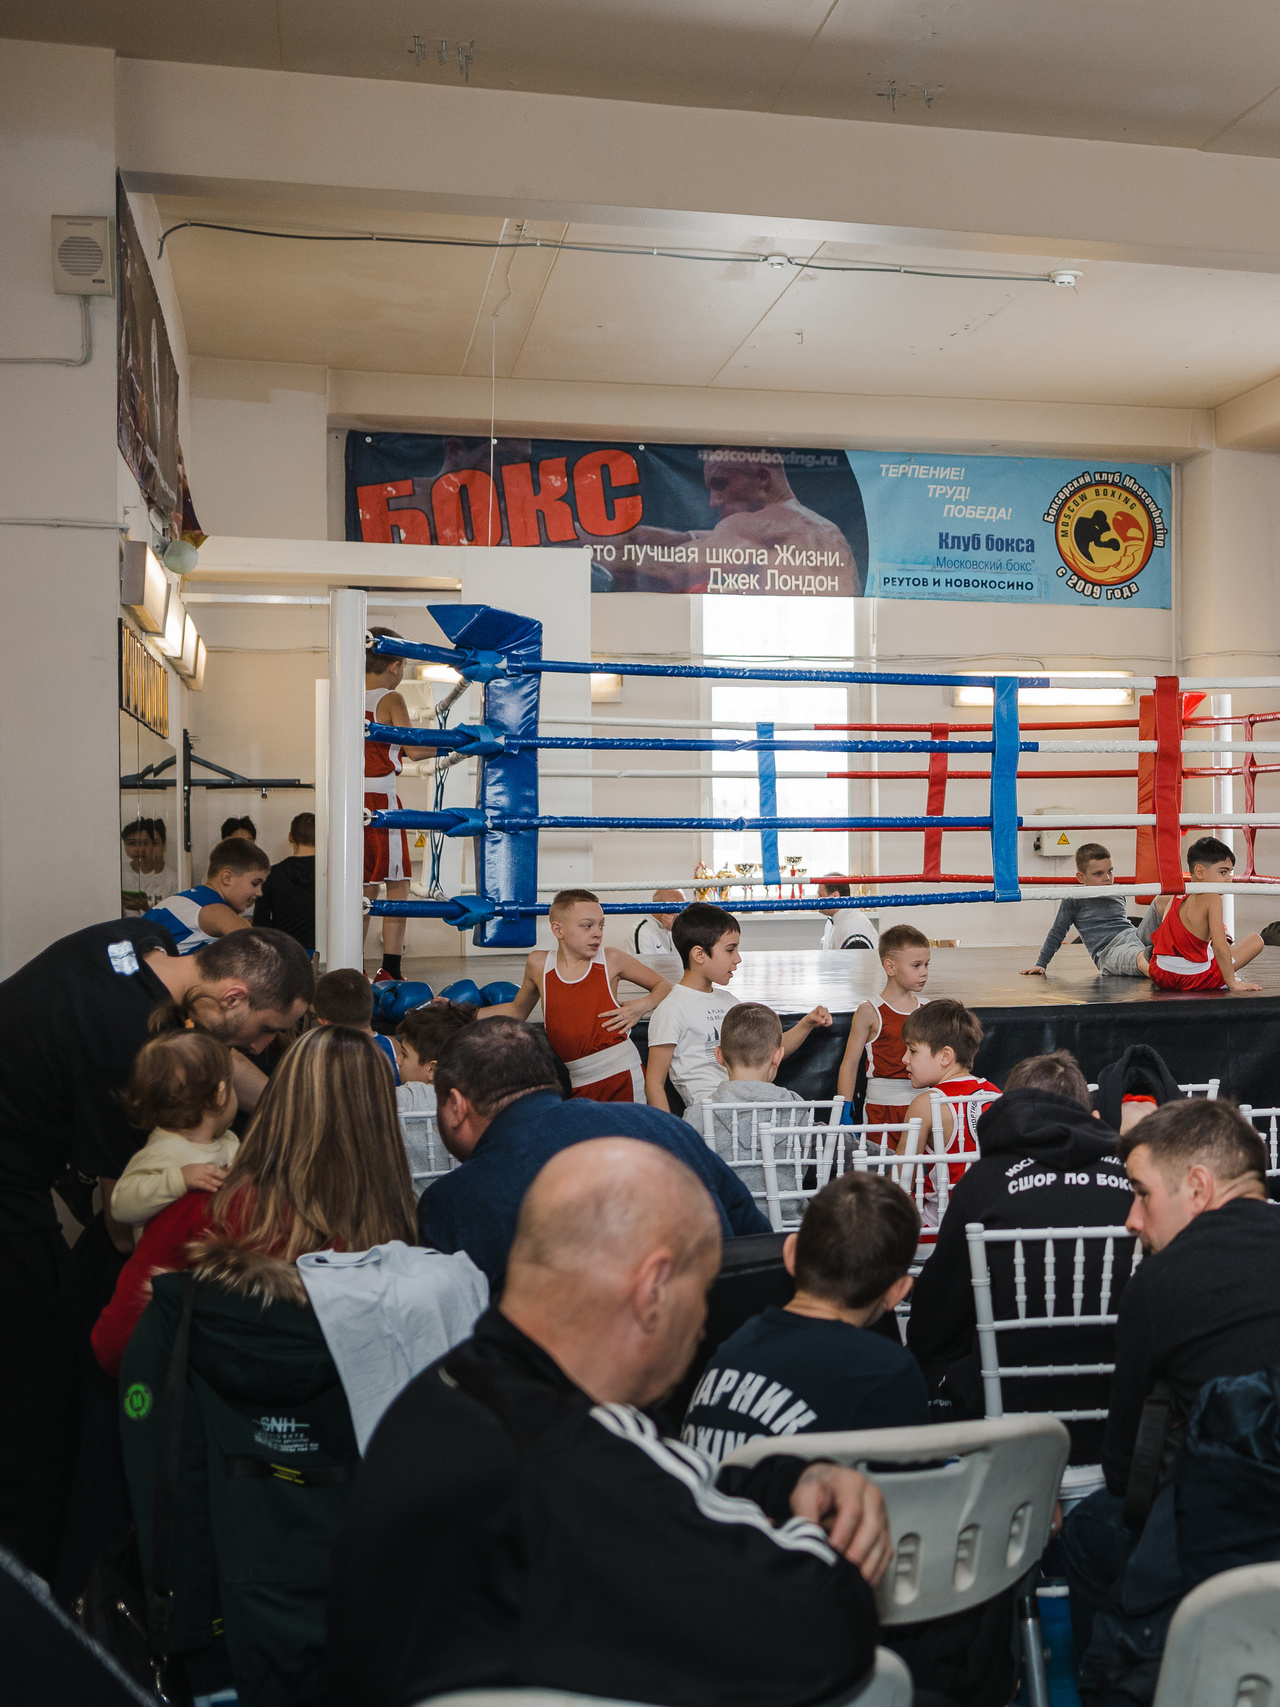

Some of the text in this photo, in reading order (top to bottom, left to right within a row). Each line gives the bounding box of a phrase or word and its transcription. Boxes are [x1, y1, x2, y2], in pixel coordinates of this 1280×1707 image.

[880, 463, 966, 481] ТЕРПЕНИЕ!
[356, 449, 643, 548] БОКС
[927, 484, 971, 502] ТРУД!
[943, 504, 1013, 522] ПОБЕДА!
[1044, 472, 1167, 548] Боксерский клуб Moscowboxing
[1061, 488, 1137, 538] MOSCOW BOXING
[938, 532, 1035, 553] Клуб бокса
[622, 544, 699, 565] лучшая
[706, 547, 769, 565] школа
[774, 544, 845, 567] Жизни.
[707, 567, 839, 595] Джек Лондон
[883, 576, 1034, 592] РЕУТОВ И НОВОКОСИНО
[1056, 566, 1139, 600] с 2009 года
[1007, 1172, 1058, 1195] СШОР
[1064, 1172, 1091, 1186] ПО
[689, 1368, 818, 1437] АРНИК
[680, 1423, 768, 1463] OXIN
